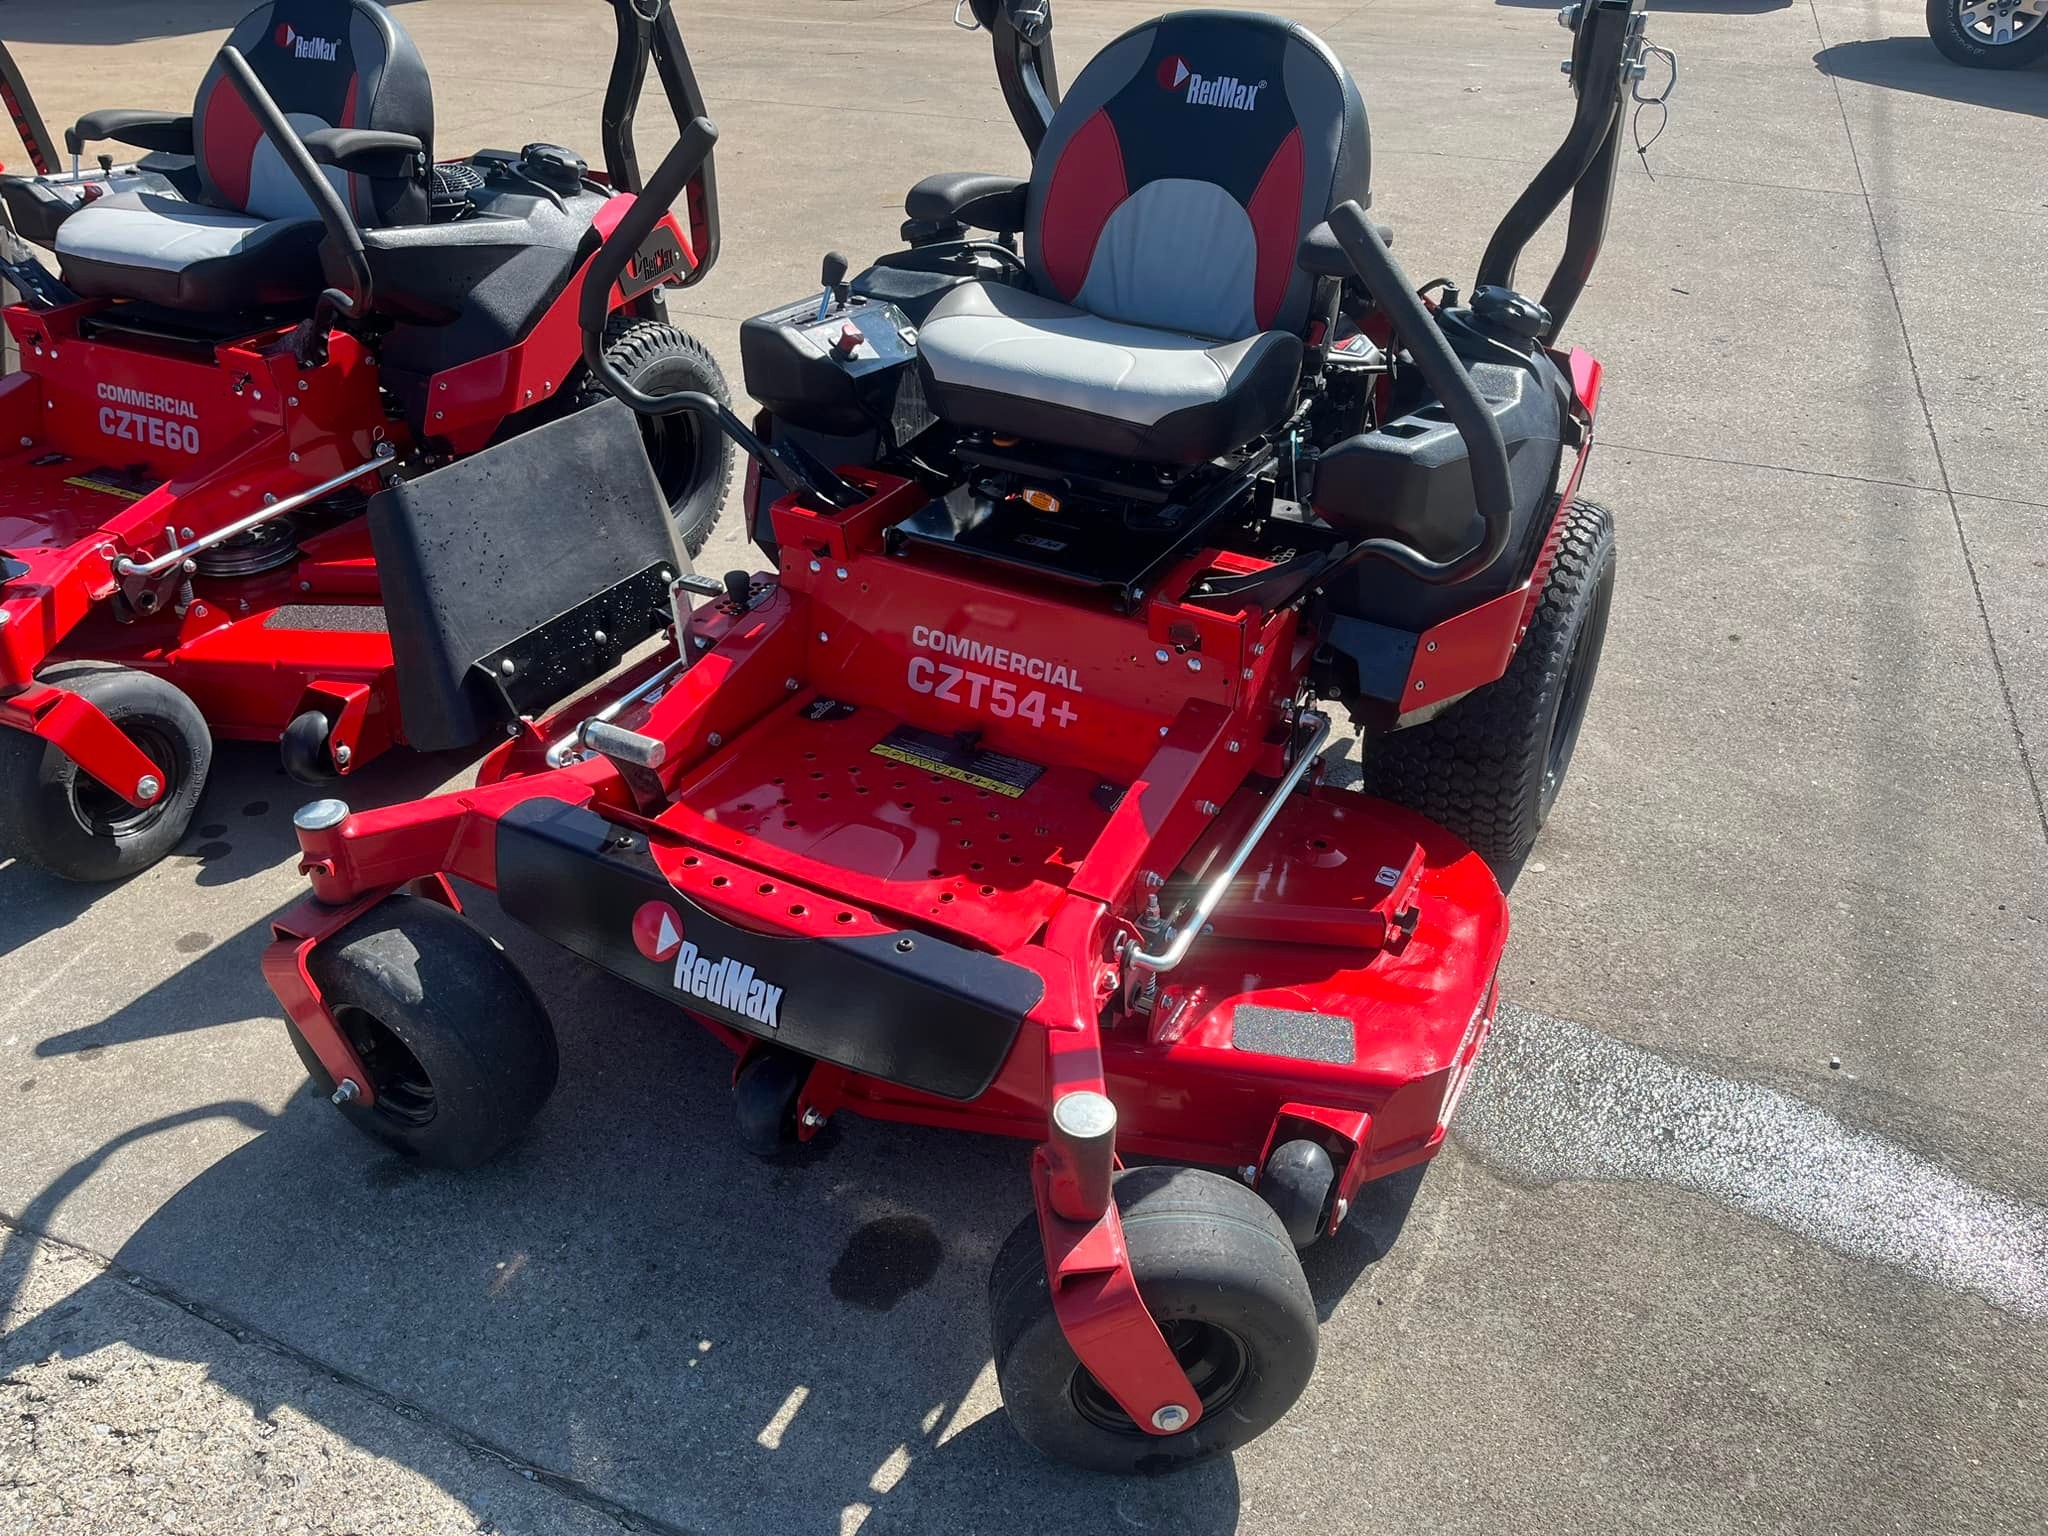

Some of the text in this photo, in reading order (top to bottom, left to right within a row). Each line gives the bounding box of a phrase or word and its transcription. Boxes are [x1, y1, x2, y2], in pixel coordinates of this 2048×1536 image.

[97, 382, 199, 419] COMMERCIAL
[99, 406, 200, 454] CZTE60
[907, 656, 1079, 729] CZT54+
[912, 625, 1083, 693] COMMERCIAL
[673, 940, 783, 1028] RedMax
